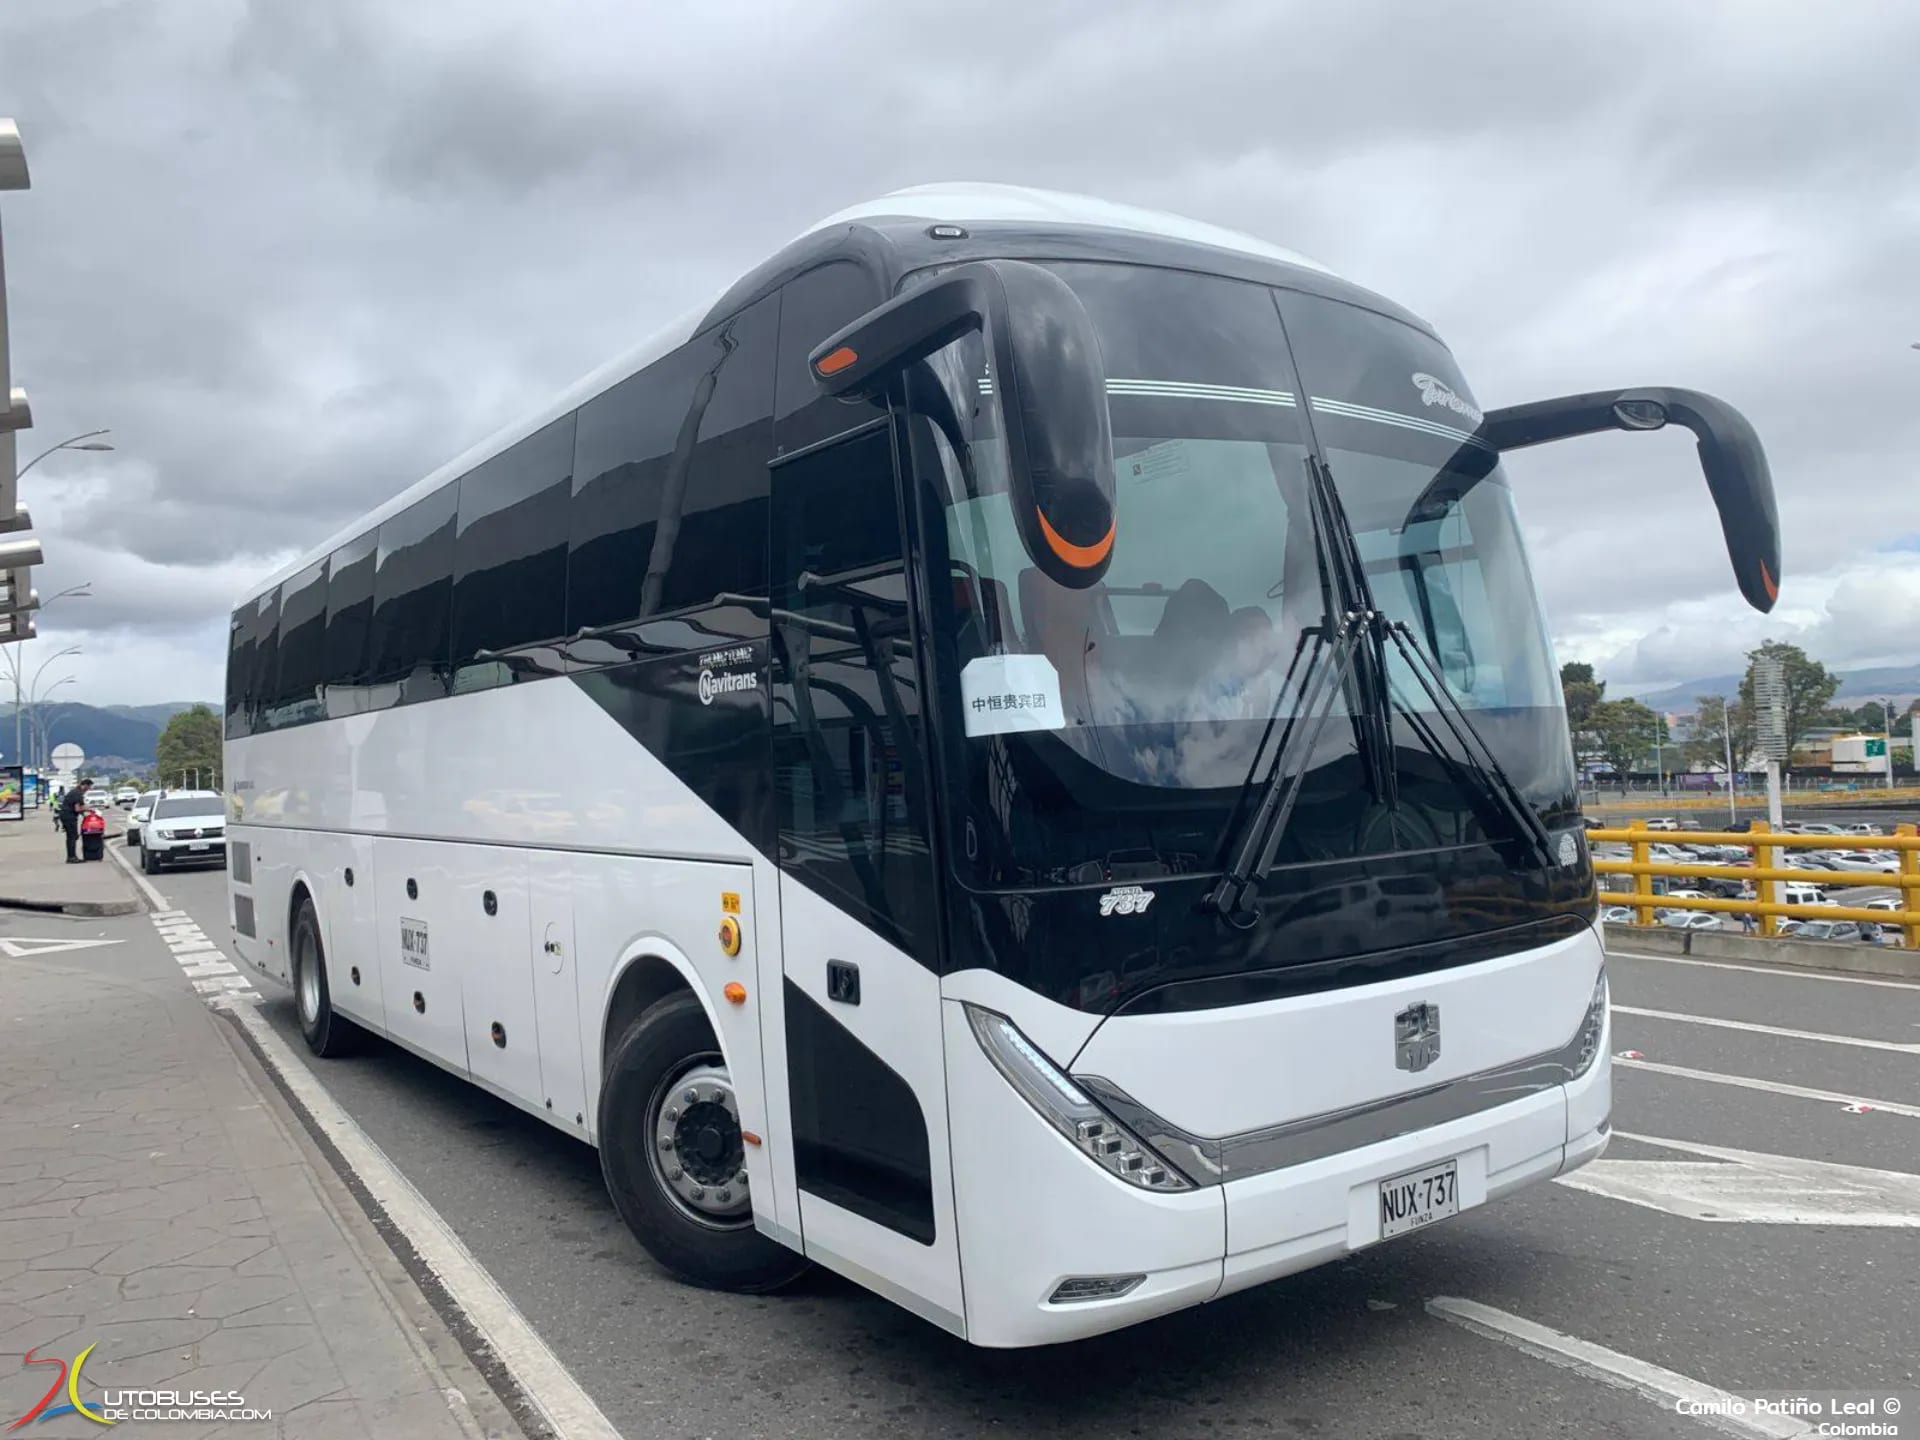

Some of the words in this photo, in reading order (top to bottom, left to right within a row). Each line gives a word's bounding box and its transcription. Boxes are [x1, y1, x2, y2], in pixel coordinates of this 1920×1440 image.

[698, 669, 757, 706] Navitrans
[971, 693, 1046, 713] 中恒贵宾团
[1099, 890, 1155, 916] 737
